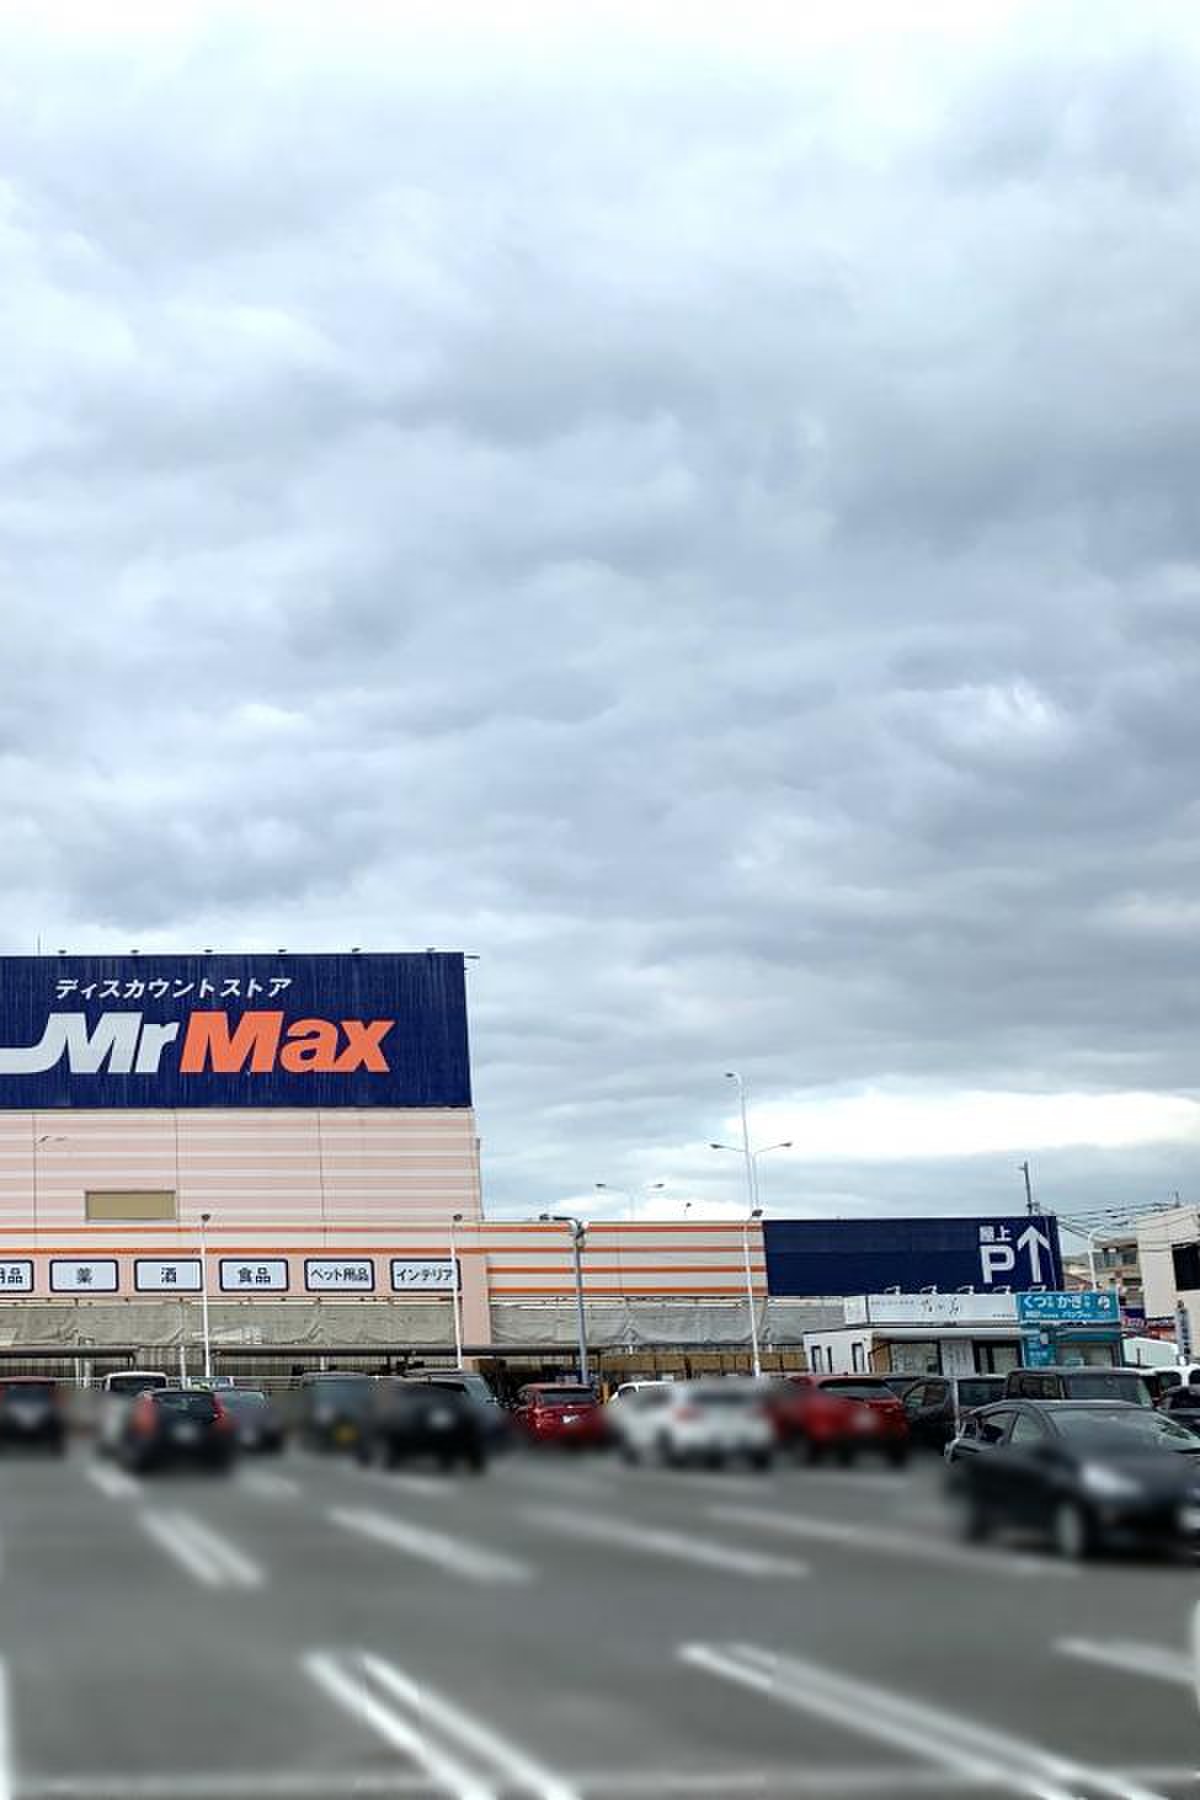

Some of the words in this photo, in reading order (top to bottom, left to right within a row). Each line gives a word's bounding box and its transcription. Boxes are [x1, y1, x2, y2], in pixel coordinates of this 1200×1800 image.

[54, 977, 292, 1000] ディスカウントストア
[980, 1245, 1015, 1283] P
[76, 1267, 93, 1284] 薬
[237, 1266, 272, 1284] 食品
[310, 1266, 369, 1282] ペット用品
[395, 1268, 454, 1282] インテリア
